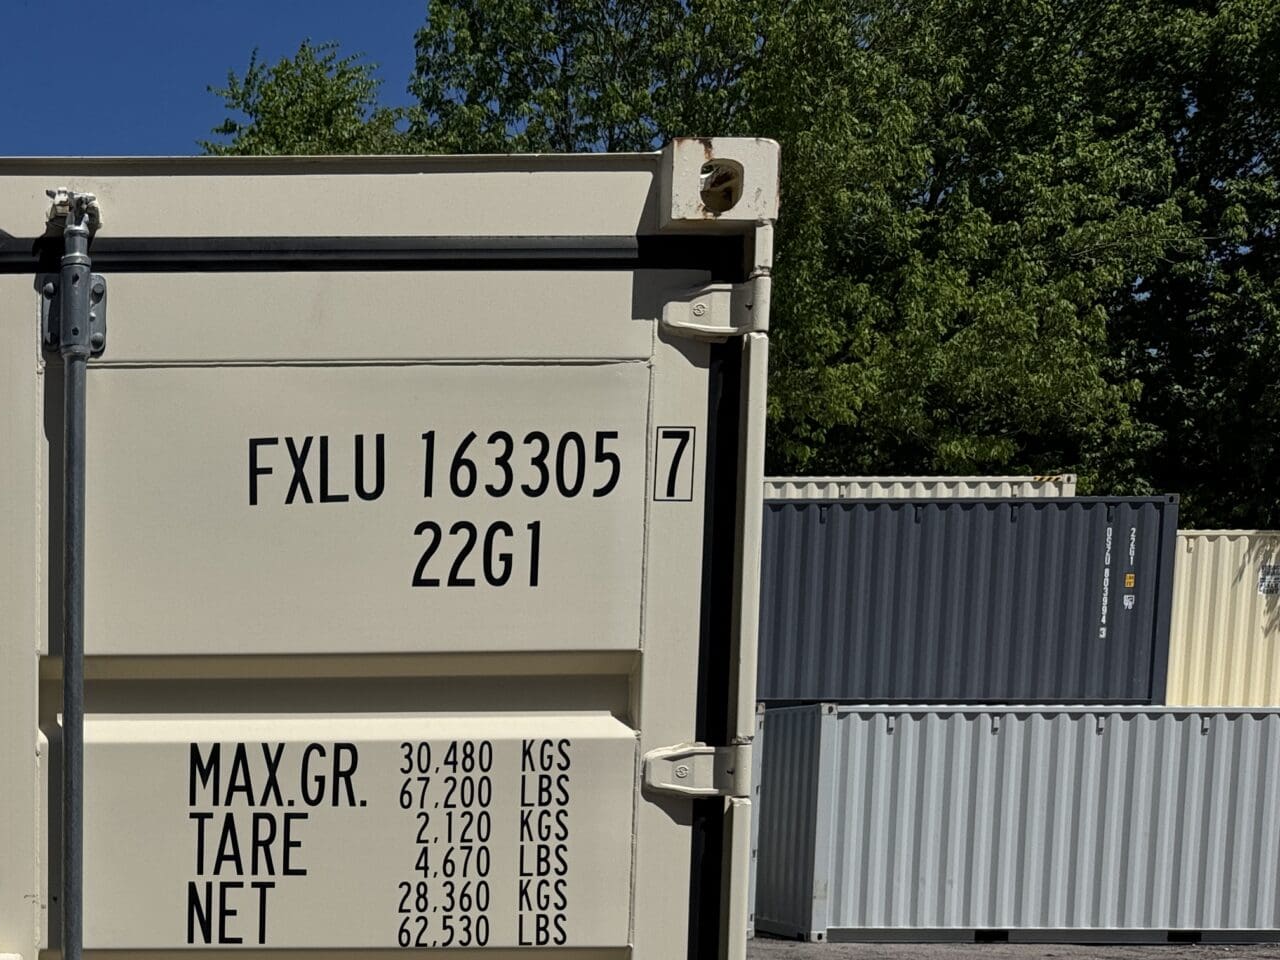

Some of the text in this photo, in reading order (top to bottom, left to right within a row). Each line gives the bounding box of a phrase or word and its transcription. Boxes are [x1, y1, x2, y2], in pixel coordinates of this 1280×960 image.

[249, 430, 690, 506] FXLU 163305 7
[412, 520, 541, 587] 22G1
[189, 738, 571, 807] MAX.GR. 30,480 KGS
[399, 774, 570, 810] 67,200 LBS
[189, 809, 569, 876] TARE 2,120 KGS
[415, 844, 569, 879] 4,670 LBS
[187, 879, 568, 945] NET 28,360 KGS
[398, 914, 567, 948] 62,530 LBS
